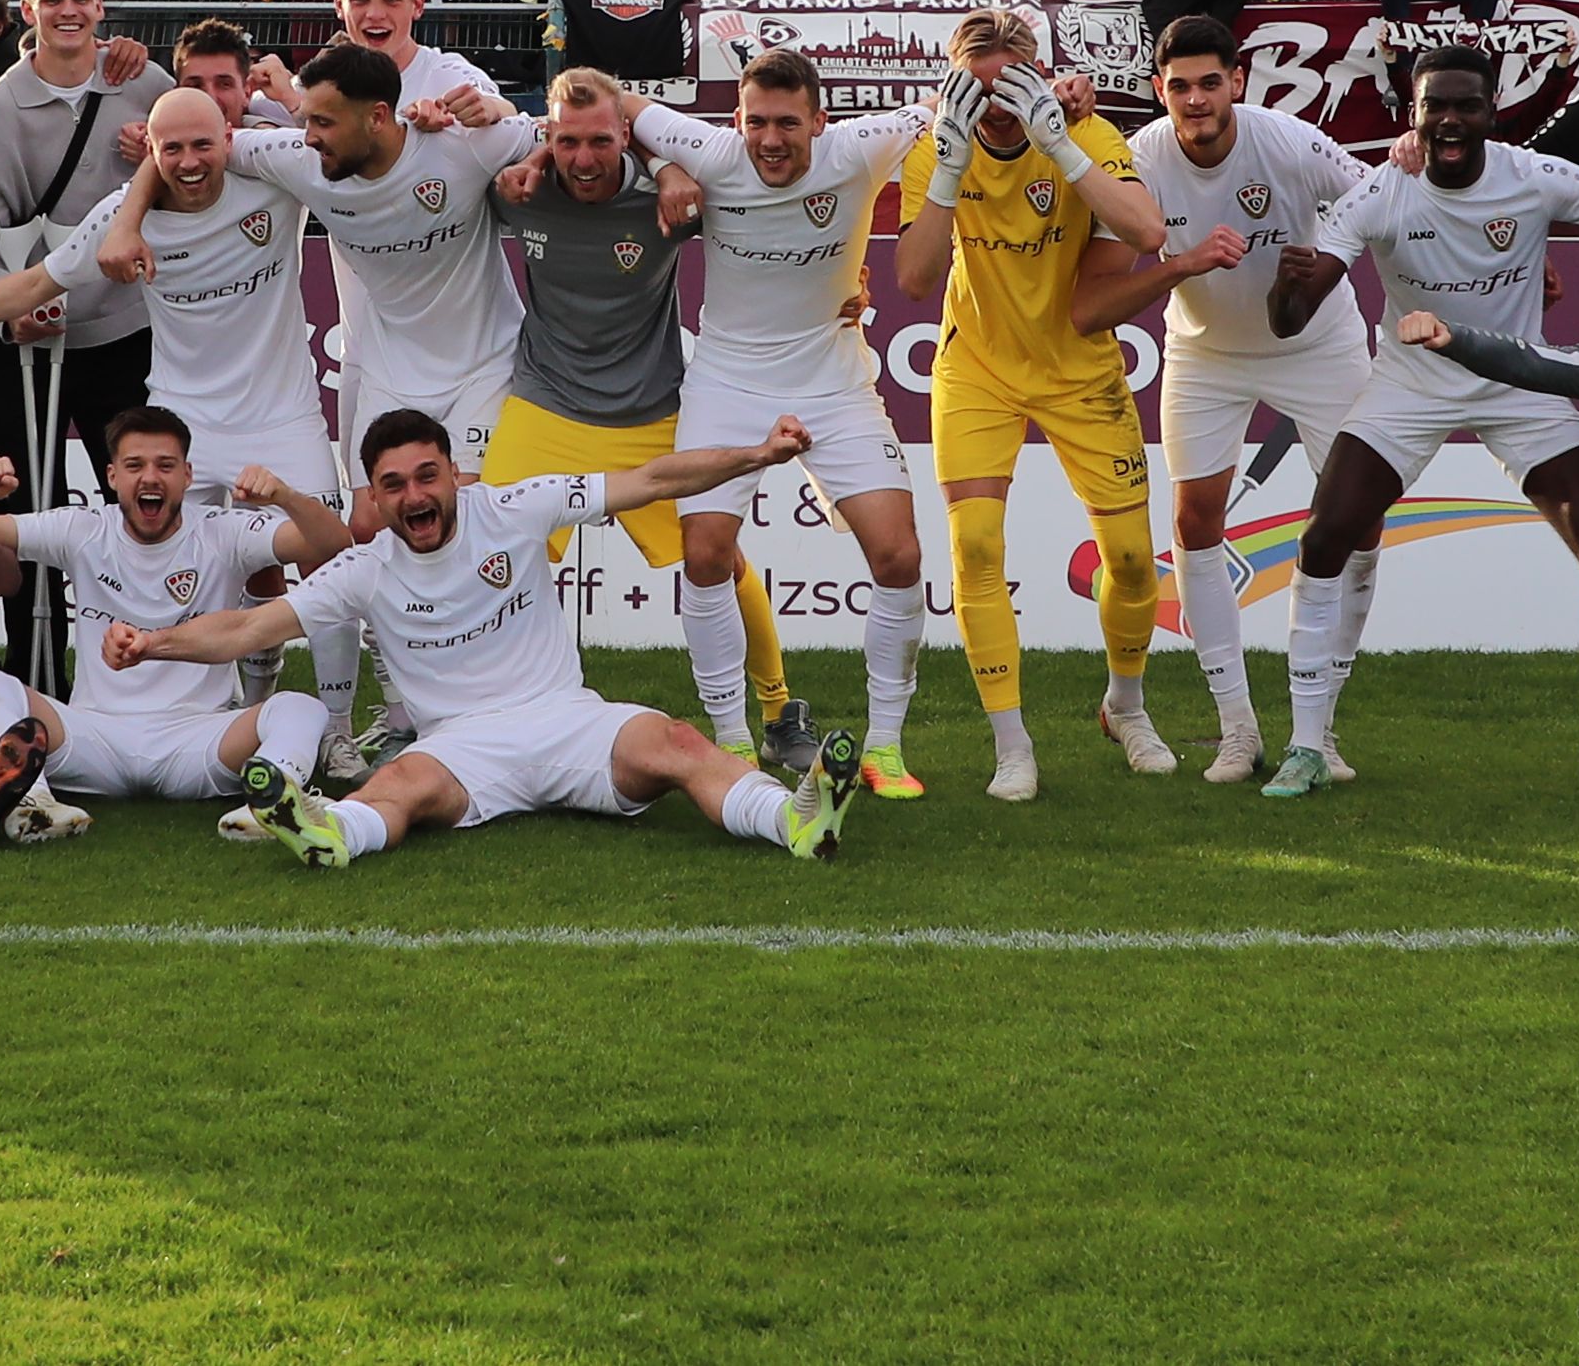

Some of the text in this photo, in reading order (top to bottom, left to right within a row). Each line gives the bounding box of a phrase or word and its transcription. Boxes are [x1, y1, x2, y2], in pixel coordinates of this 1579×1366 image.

[930, 58, 949, 70] WE
[621, 82, 666, 98] 954
[960, 190, 984, 202] JAKO
[1164, 216, 1188, 227] AKO
[523, 229, 548, 243] JAKO
[1408, 231, 1435, 241] JAKO
[163, 251, 189, 262] JAKO
[526, 242, 543, 260] 79
[713, 235, 846, 265] crunchfit
[163, 258, 283, 304] crunchfit
[98, 573, 123, 592] JAKO
[406, 603, 434, 614] JAKO
[408, 589, 532, 650] crunchfit
[319, 681, 352, 692] JAKO
